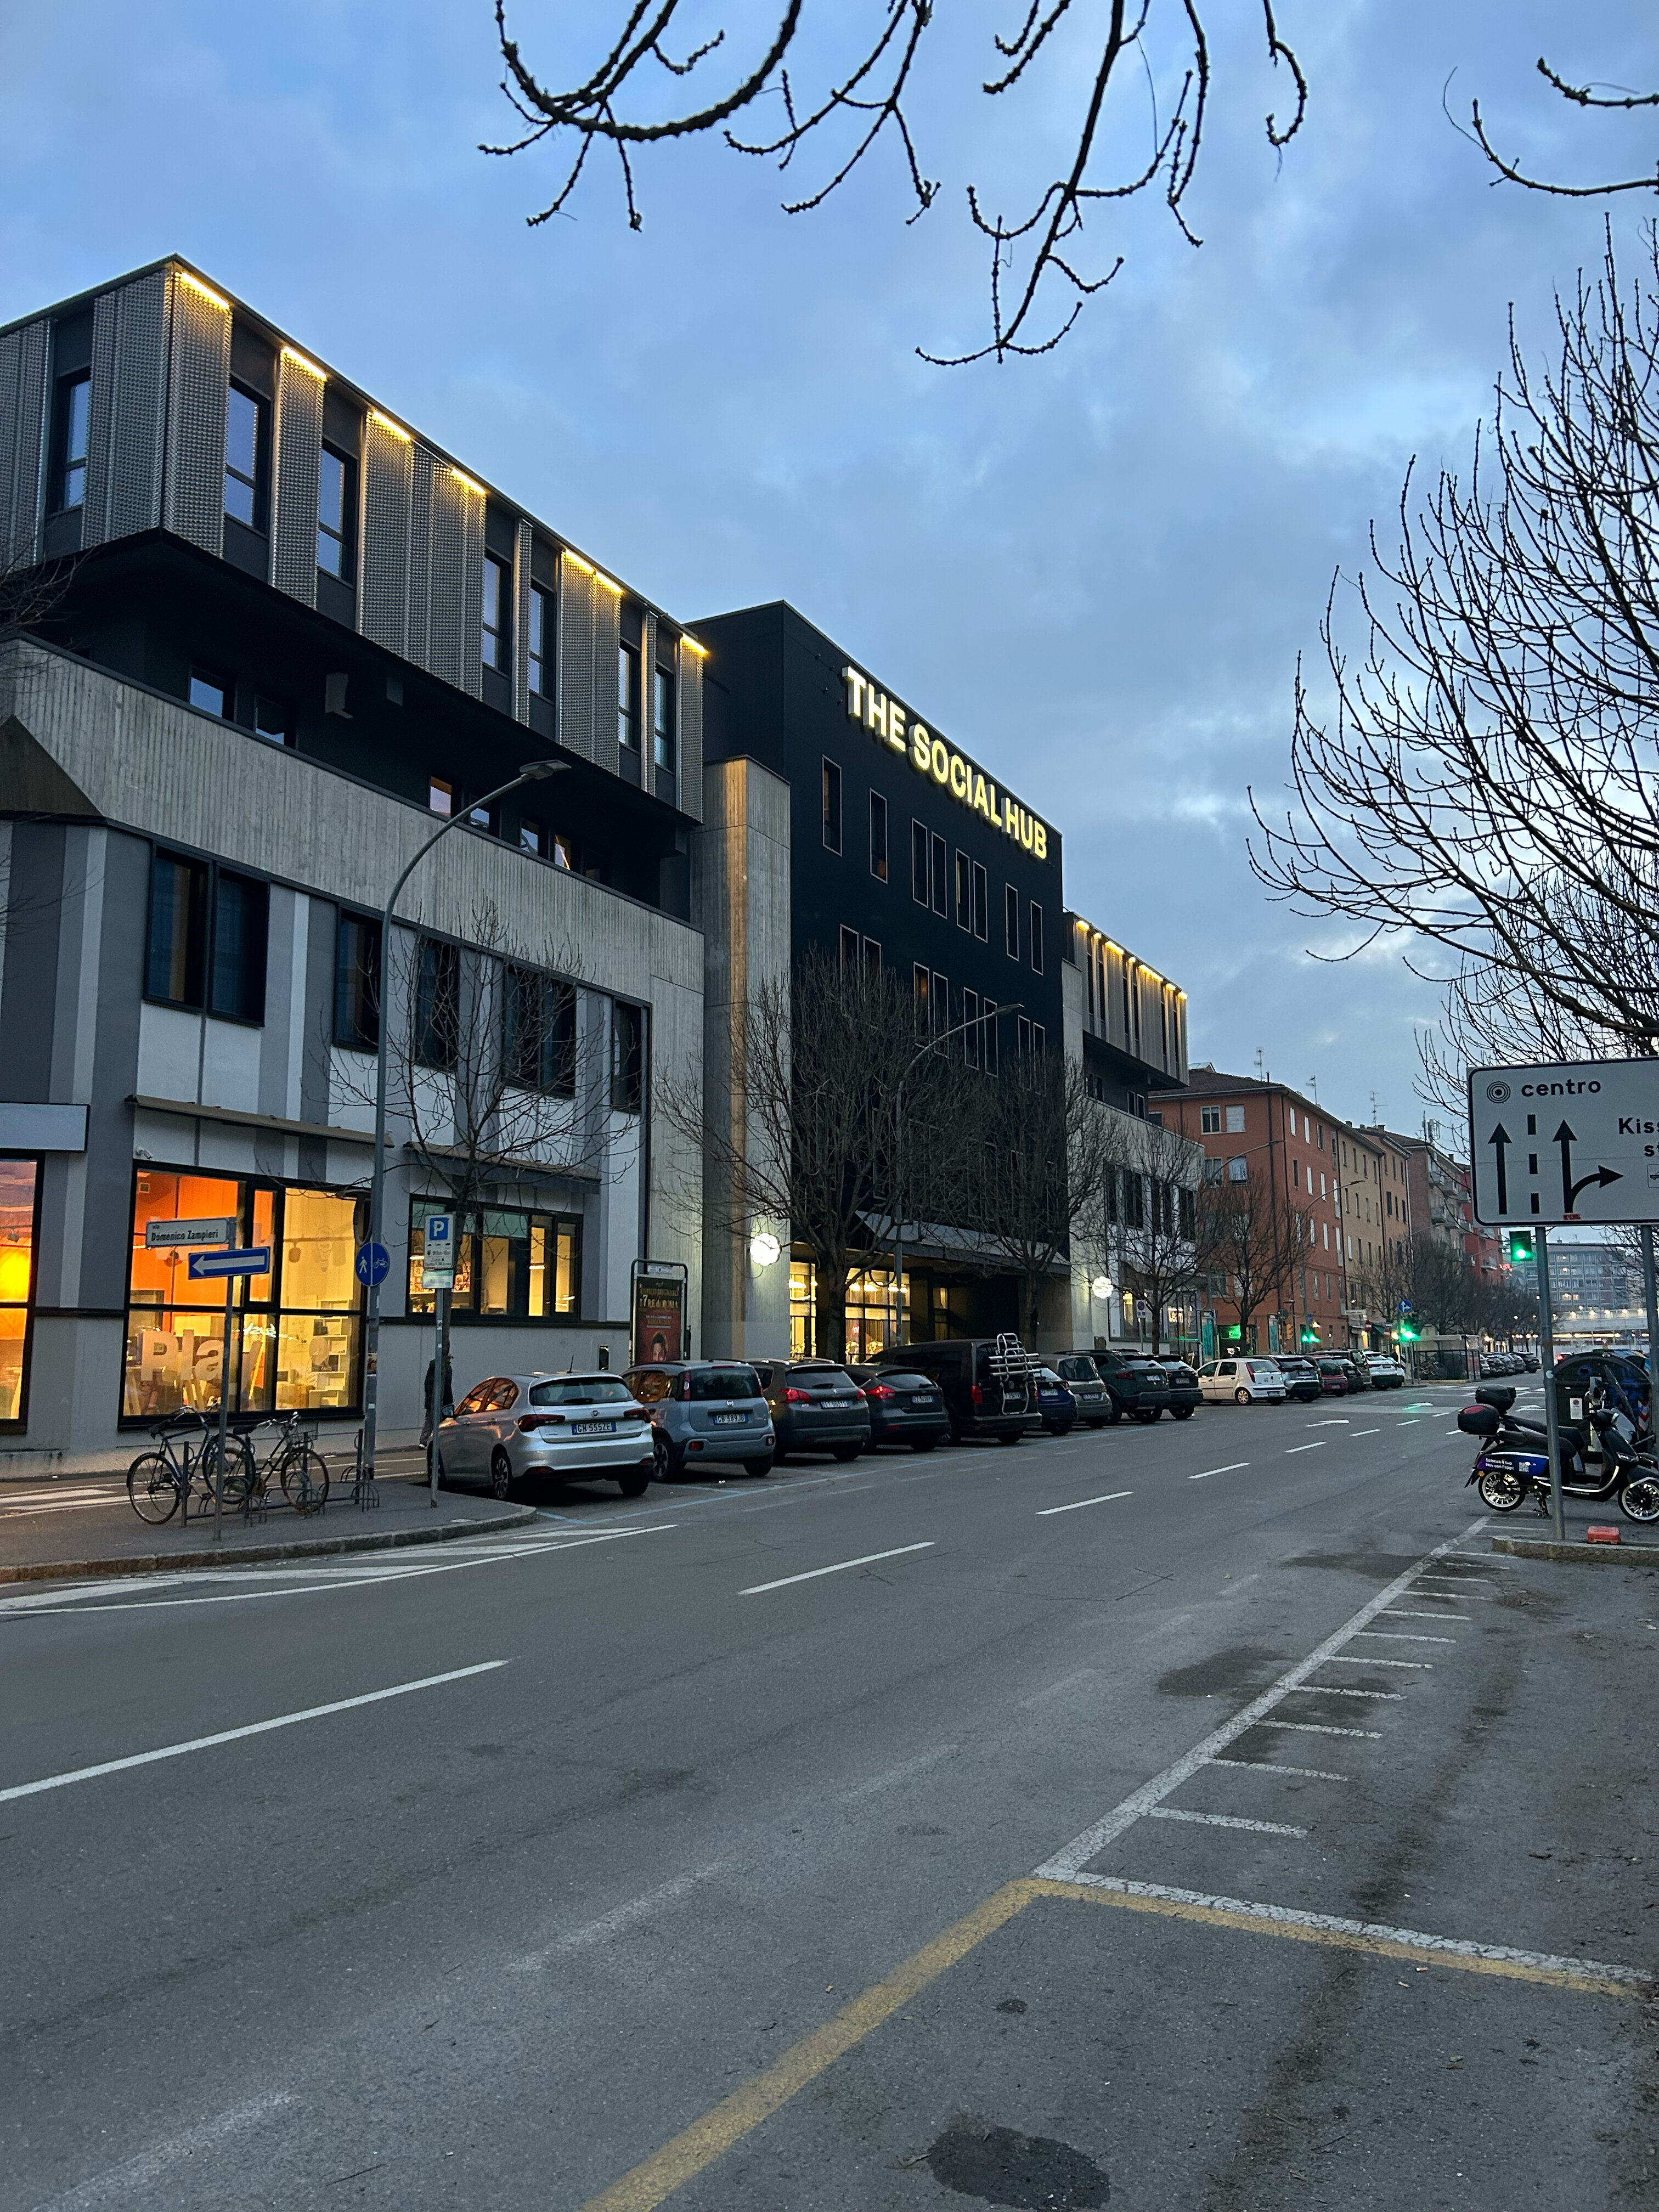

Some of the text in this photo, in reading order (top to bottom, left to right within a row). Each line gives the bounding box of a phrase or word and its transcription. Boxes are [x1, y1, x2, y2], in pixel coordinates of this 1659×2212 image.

[842, 665, 1047, 859] THE SOCIAL HUB
[1521, 1079, 1601, 1097] centro
[1618, 1117, 1659, 1135] Kis
[151, 1229, 218, 1241] Domenico Zampieri
[433, 1221, 444, 1237] P
